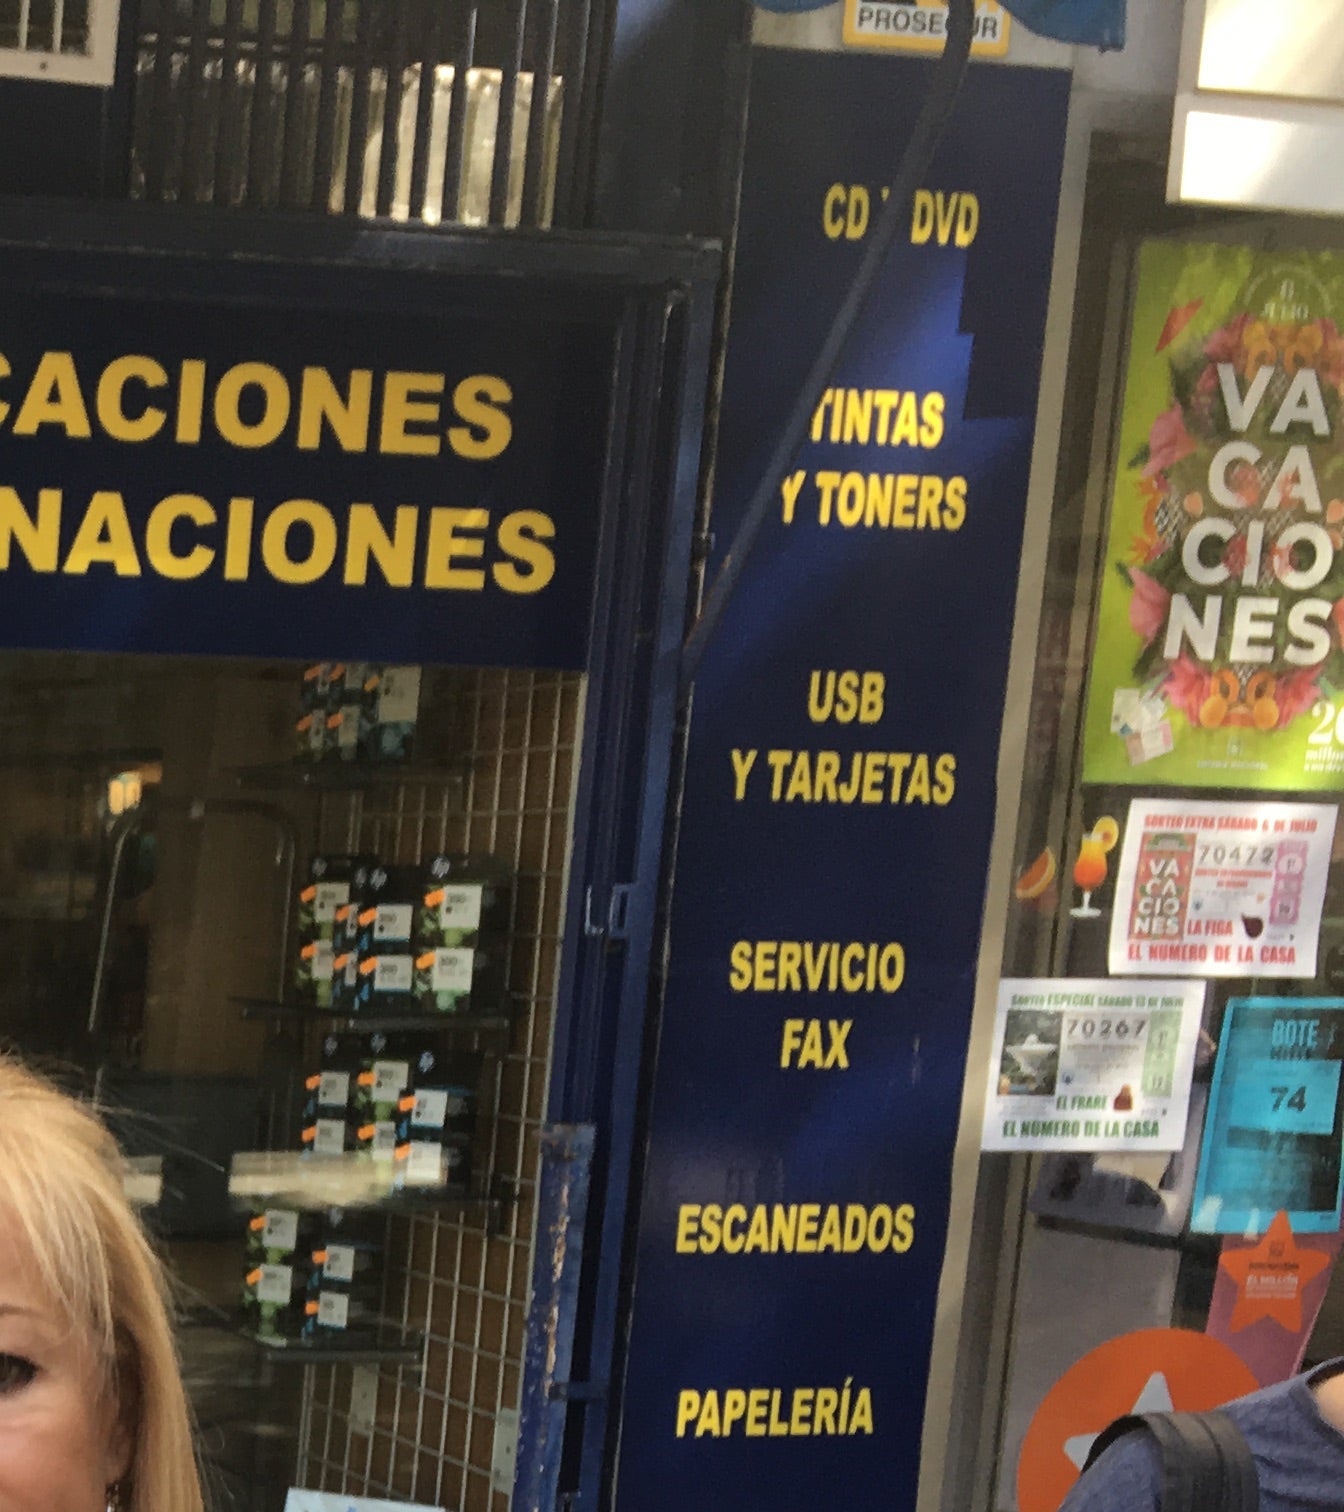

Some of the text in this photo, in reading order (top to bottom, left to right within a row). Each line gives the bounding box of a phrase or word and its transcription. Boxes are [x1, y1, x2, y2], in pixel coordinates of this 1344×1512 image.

[858, 7, 998, 39] PROSER
[823, 183, 979, 247] CD DVD
[811, 388, 945, 449] TINTAS
[1217, 362, 1330, 436] VA
[781, 470, 967, 530] Y TONERS
[1208, 440, 1323, 513] CA
[1182, 517, 1334, 590] CIO
[1163, 592, 1334, 666] NES
[808, 670, 885, 724] USB
[731, 749, 956, 806] Y TARJETAS
[1145, 878, 1179, 897] CA
[1149, 858, 1180, 877] VA
[1133, 916, 1180, 935] NES
[1139, 897, 1180, 917] CIO
[1187, 919, 1202, 936] LA
[729, 940, 905, 993] SERVICIO
[1128, 943, 1142, 961] EL
[1214, 944, 1231, 962] DE
[1238, 944, 1254, 963] LA
[1261, 945, 1296, 964] CASA
[780, 1019, 852, 1069] FAX
[1067, 1019, 1148, 1038] 70267
[1272, 1019, 1320, 1049] BOTE
[1270, 1085, 1307, 1112] 74
[1003, 1119, 1017, 1138] EL
[1084, 1119, 1101, 1137] DE
[1104, 1120, 1120, 1138] LA
[1123, 1120, 1160, 1138] CASA
[675, 1204, 915, 1254] ESCANEADOS
[675, 1378, 874, 1437] PAPELERÍA
